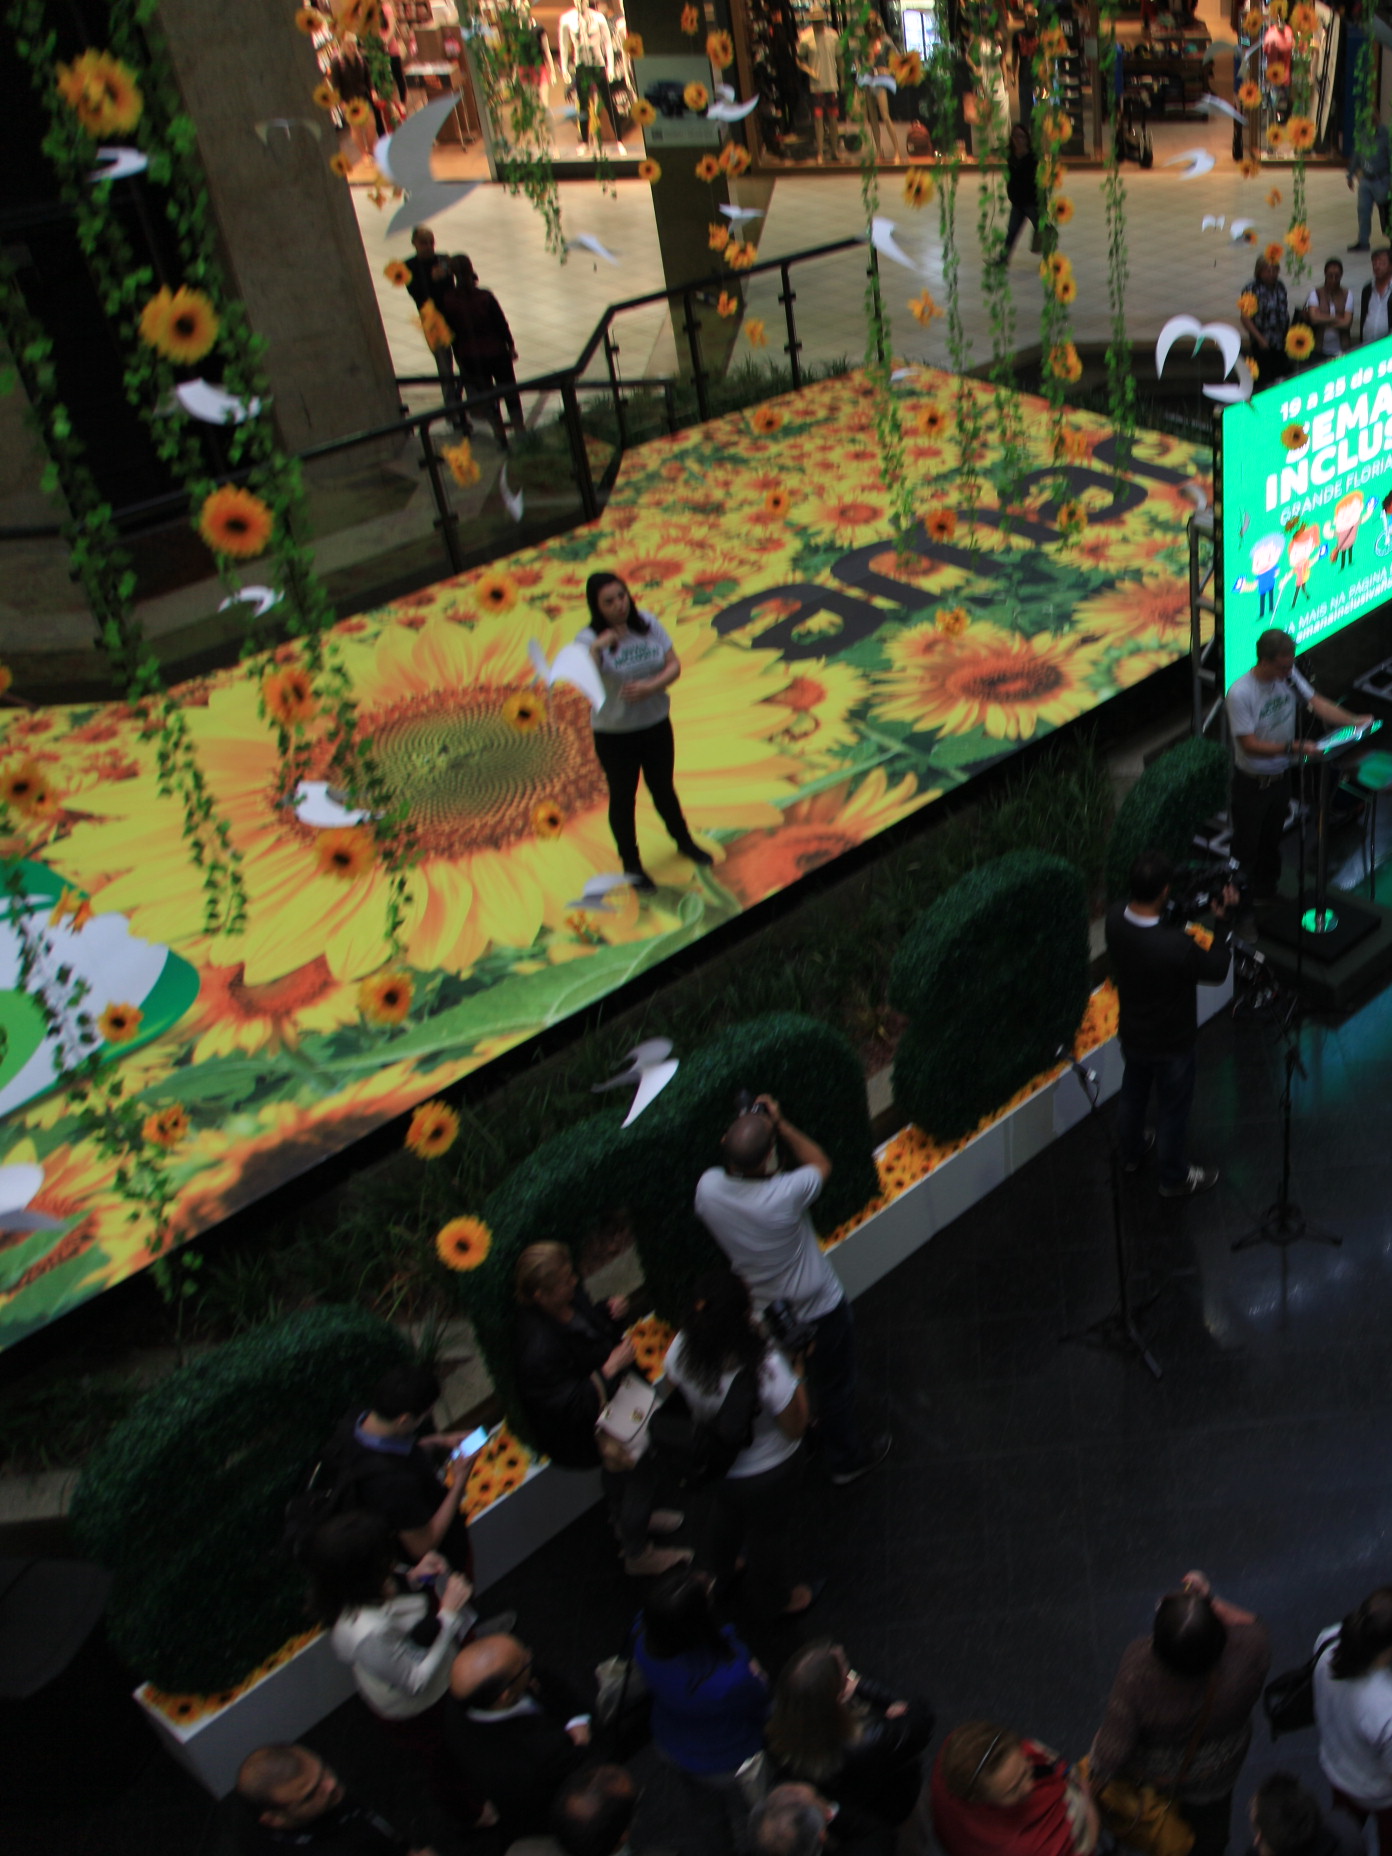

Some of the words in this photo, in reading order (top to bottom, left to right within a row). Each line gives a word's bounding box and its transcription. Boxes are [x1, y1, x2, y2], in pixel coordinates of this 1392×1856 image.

[1280, 396, 1302, 422] 19
[1306, 391, 1319, 410] a
[1323, 375, 1346, 403] 25
[1350, 366, 1374, 390] de
[1280, 479, 1343, 526] GRANDE
